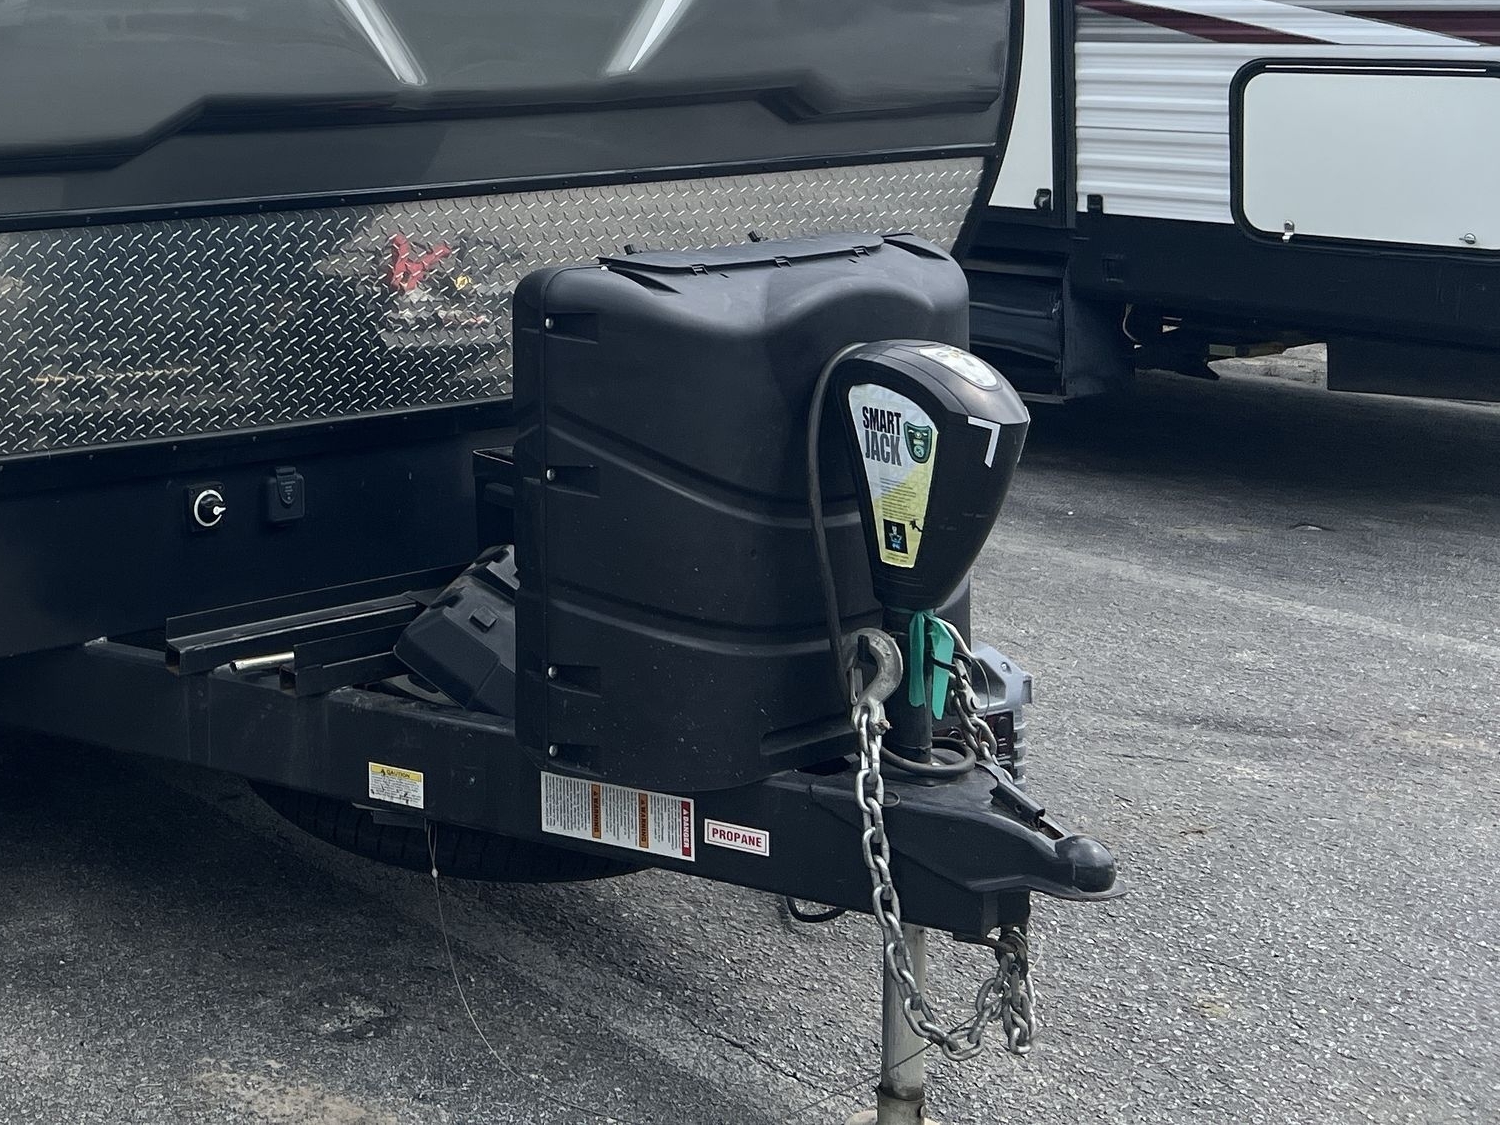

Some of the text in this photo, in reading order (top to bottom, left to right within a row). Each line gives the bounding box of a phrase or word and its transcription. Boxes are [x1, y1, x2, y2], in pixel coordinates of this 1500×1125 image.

[862, 406, 901, 435] SMART
[865, 429, 902, 466] JACK
[712, 827, 762, 848] PROPANE
